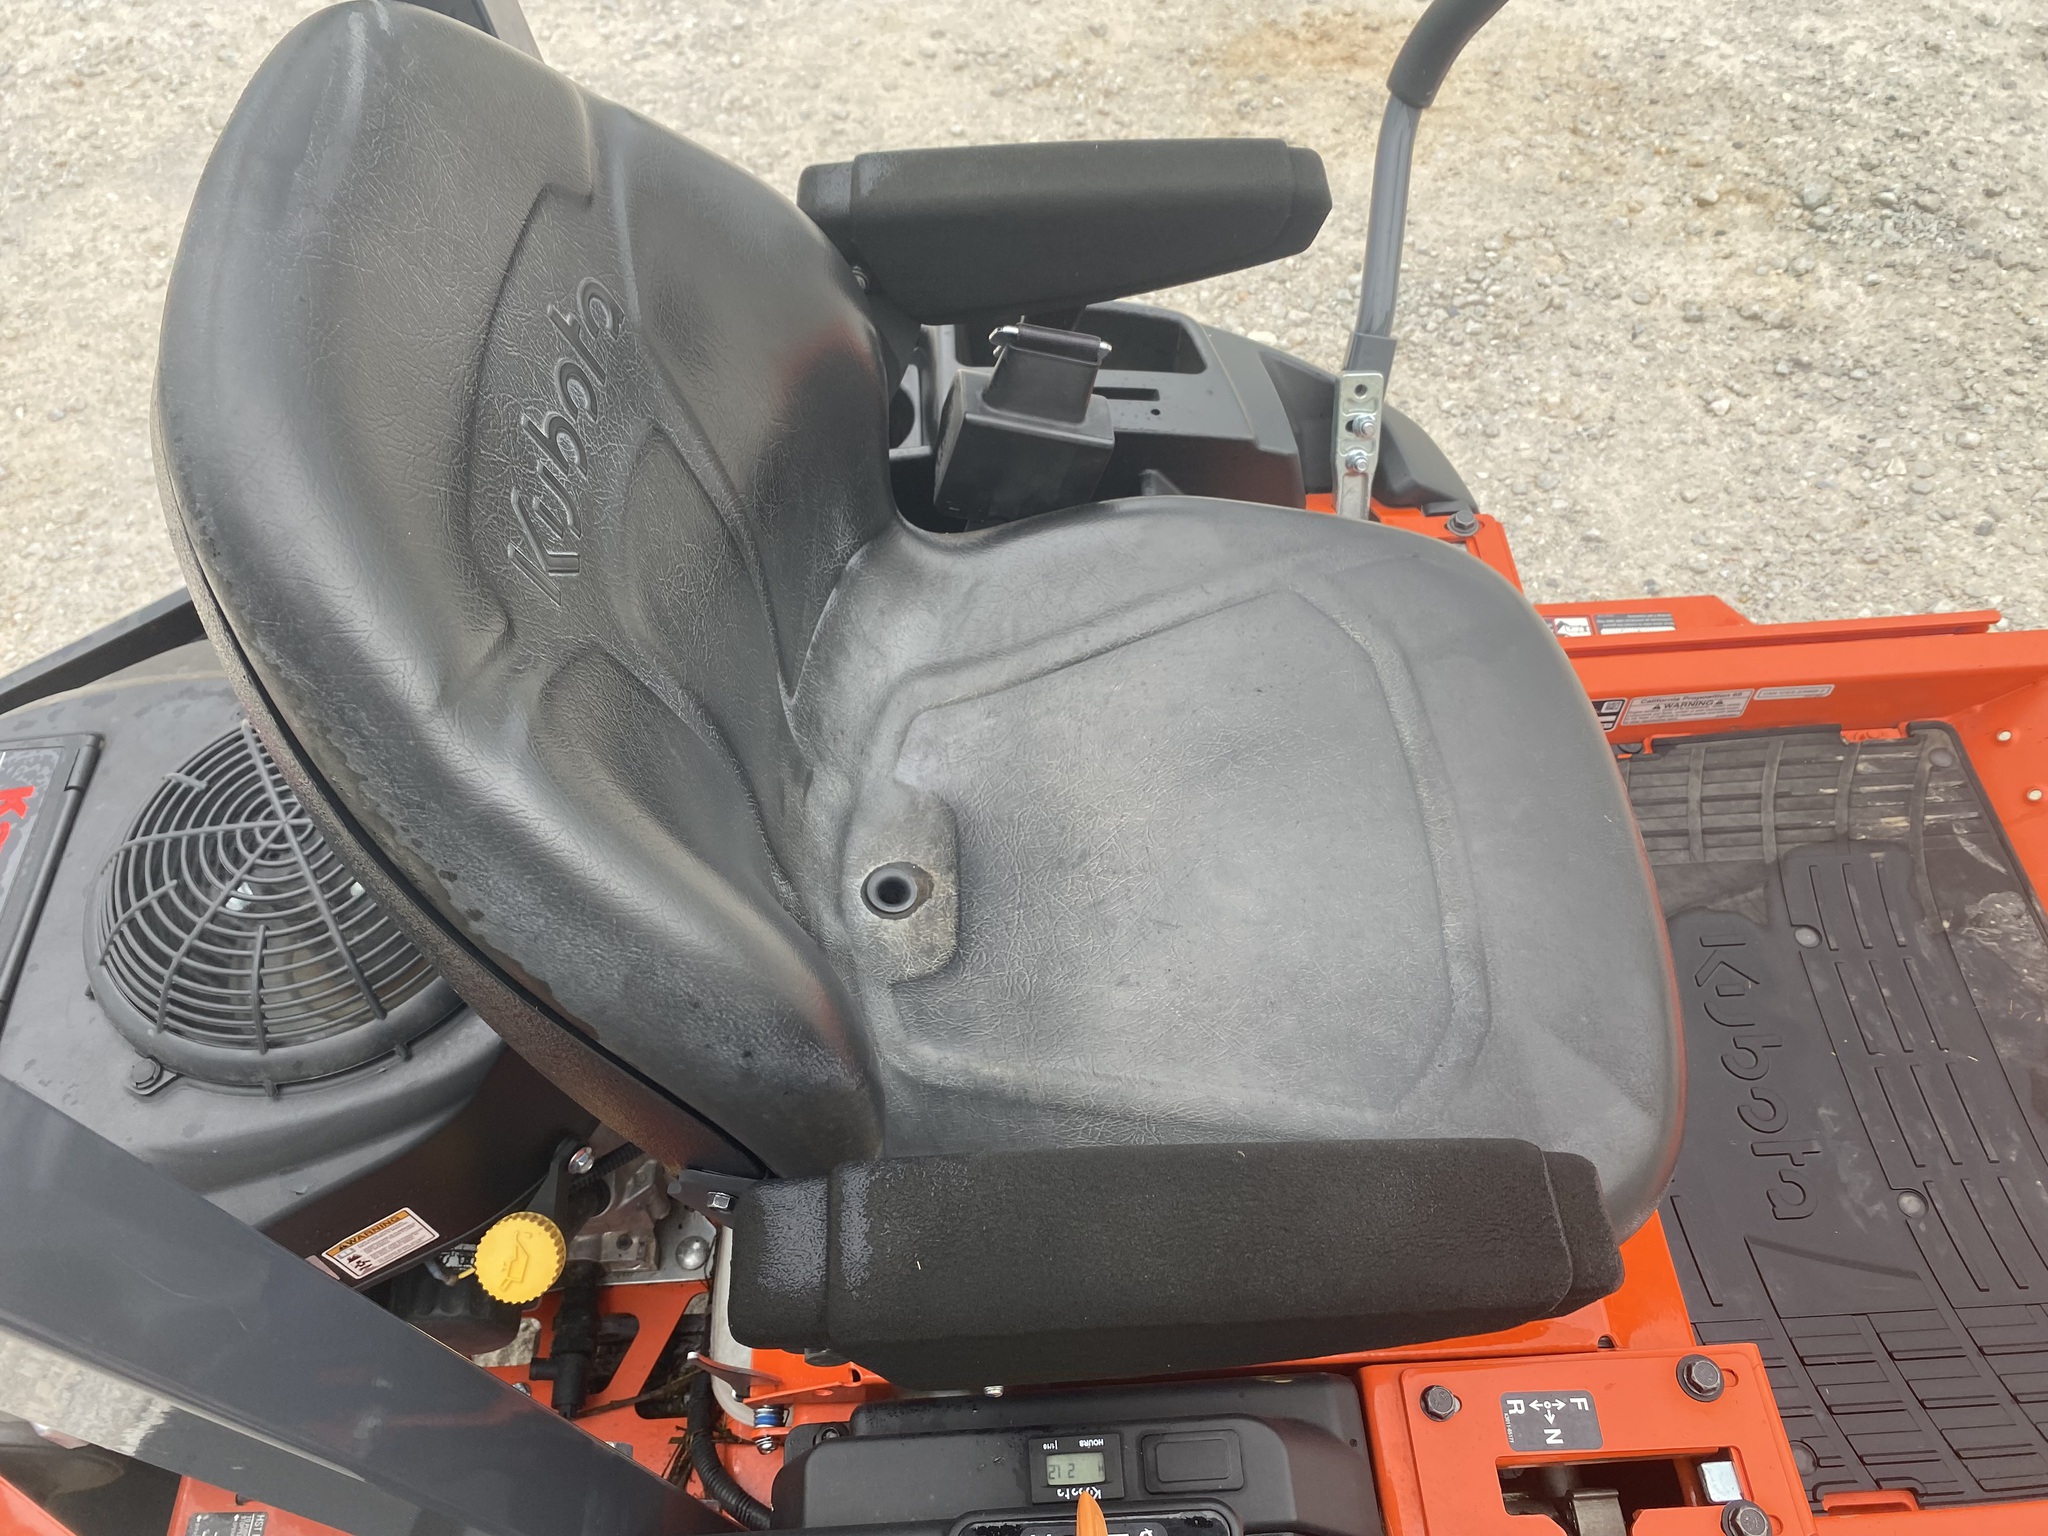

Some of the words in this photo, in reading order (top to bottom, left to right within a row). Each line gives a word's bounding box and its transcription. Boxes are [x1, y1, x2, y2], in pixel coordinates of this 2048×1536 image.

[508, 276, 625, 607] Kubota
[1664, 700, 1713, 709] WARNING
[1694, 933, 1822, 1221] Kubota
[346, 1216, 400, 1246] WARNING
[1506, 1399, 1526, 1415] R
[1569, 1397, 1589, 1411] F
[1079, 1438, 1104, 1448] HOURS
[1543, 1428, 1564, 1445] N
